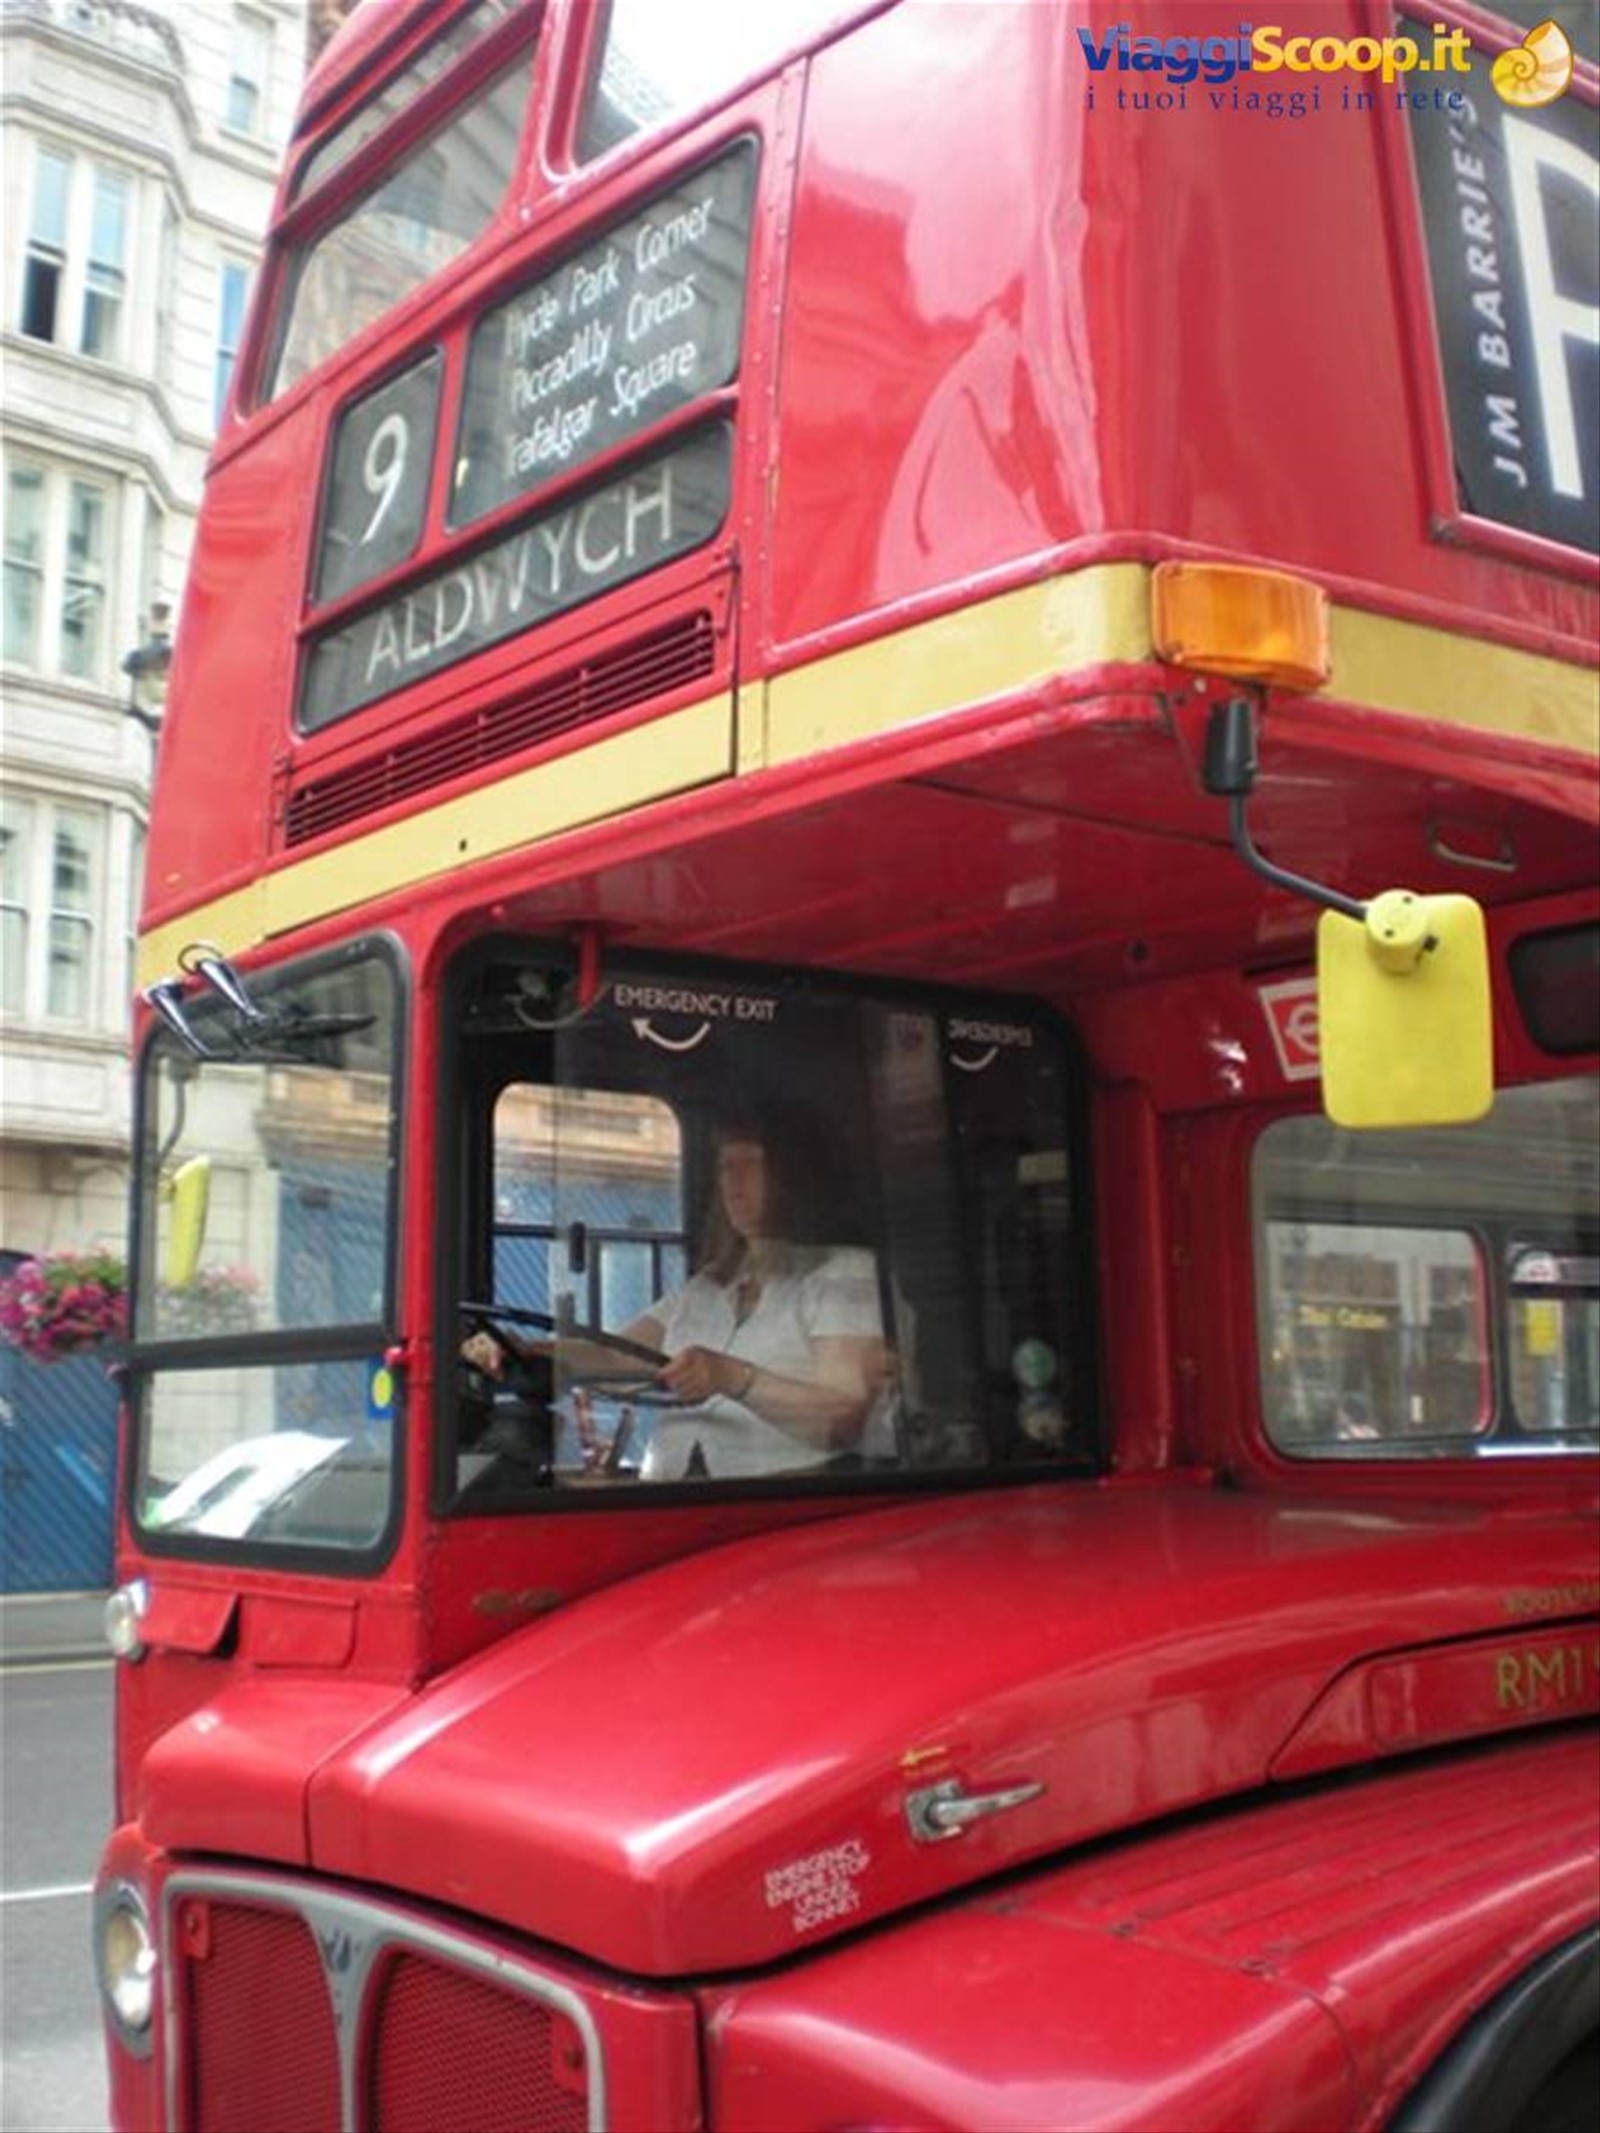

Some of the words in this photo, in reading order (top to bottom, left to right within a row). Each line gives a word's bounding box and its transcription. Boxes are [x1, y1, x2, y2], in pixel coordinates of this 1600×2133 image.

[504, 288, 560, 361] Hyde
[568, 248, 621, 316] Park
[636, 198, 713, 273] Corner
[1446, 92, 1512, 369] BARRIE'S
[511, 318, 613, 416] Piccadilly
[627, 274, 696, 342] Circus
[609, 341, 696, 416] Square
[362, 414, 409, 545] 9
[366, 466, 673, 684] ALDWYCH
[614, 985, 730, 1016] EMERGENCY
[734, 997, 778, 1021] EXIT
[1496, 1640, 1600, 1708] RM1
